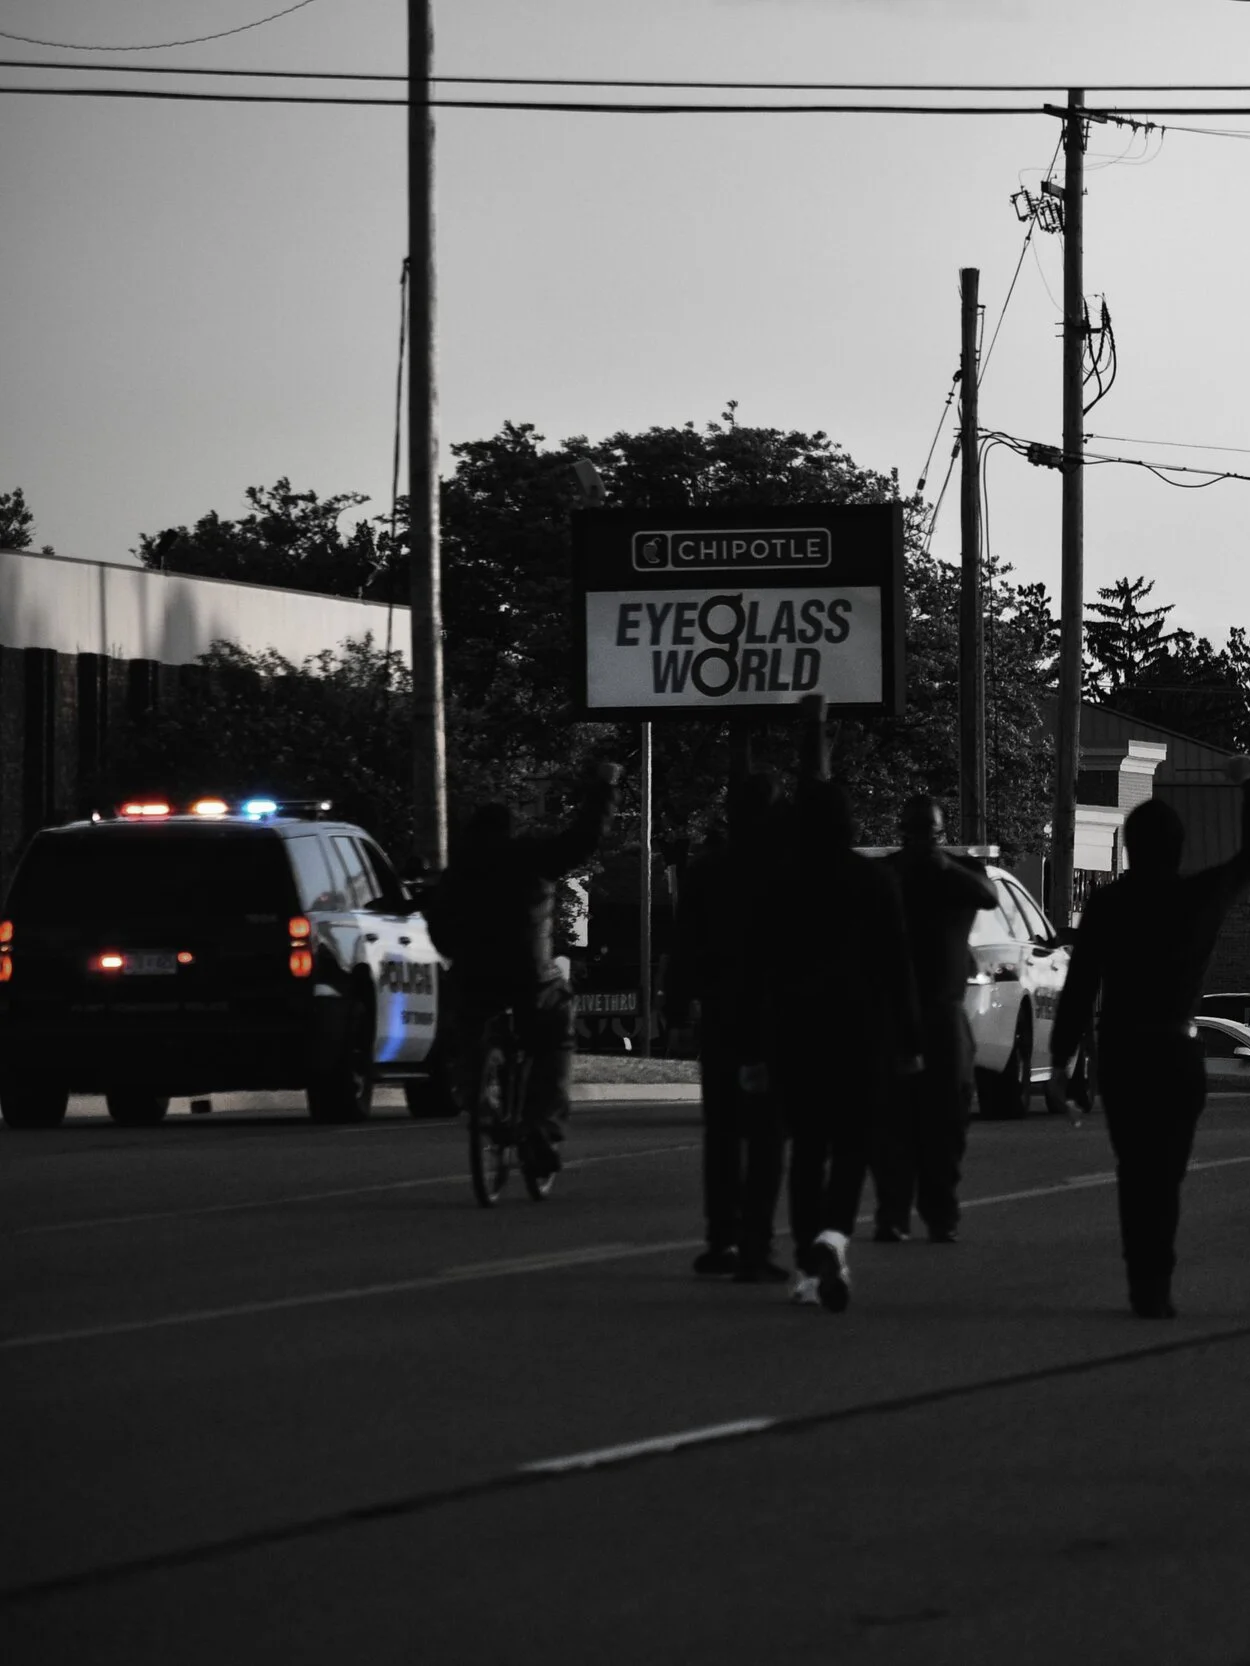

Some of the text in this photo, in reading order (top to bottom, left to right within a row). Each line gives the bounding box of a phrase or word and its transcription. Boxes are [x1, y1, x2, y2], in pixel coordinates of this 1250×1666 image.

[677, 537, 822, 561] CHIPOTLE
[616, 593, 853, 650] EYEGLASS
[652, 647, 822, 697] WORLD
